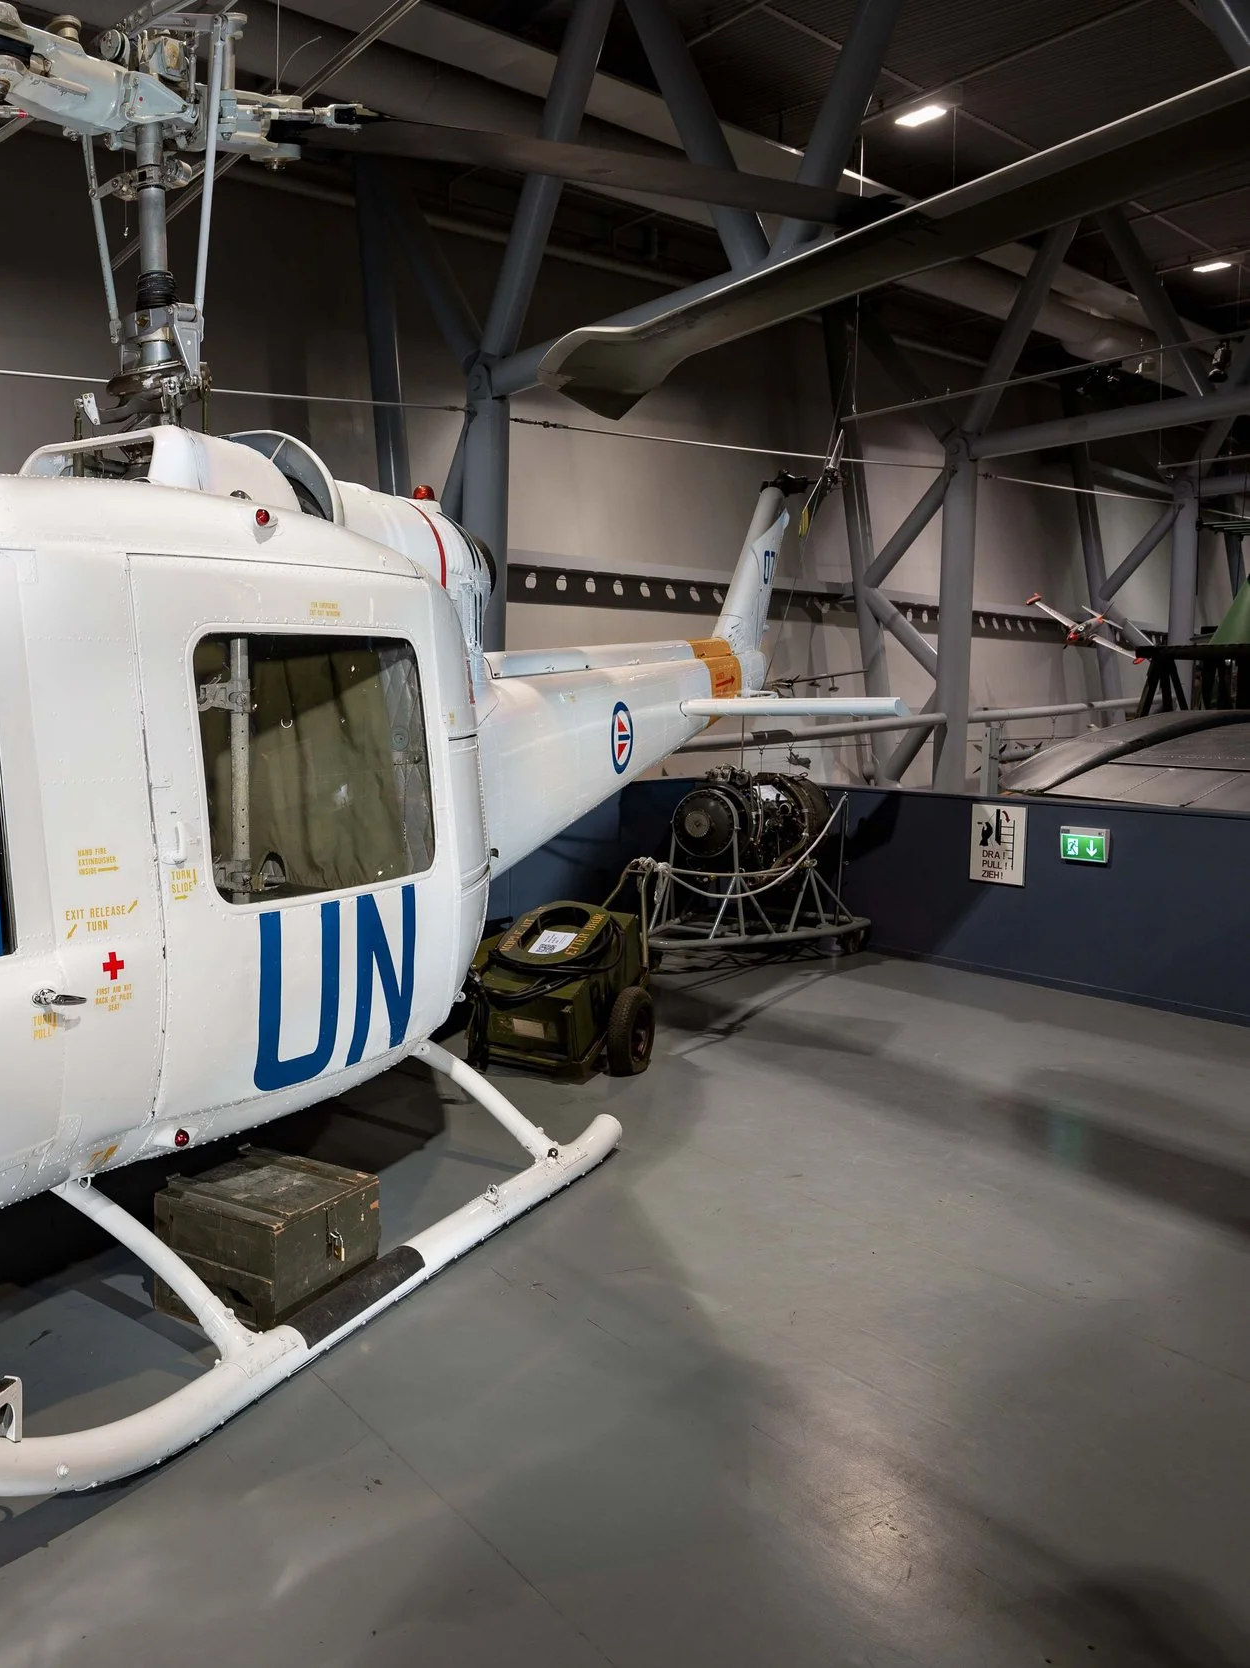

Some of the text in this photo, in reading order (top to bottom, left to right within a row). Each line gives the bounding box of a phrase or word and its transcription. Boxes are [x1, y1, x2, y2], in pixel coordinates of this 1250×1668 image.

[78, 847, 107, 857] HAND FIRE
[982, 850, 1001, 859] DRA
[78, 856, 117, 866] EXTINGUISHER
[982, 860, 1002, 869] PULL
[79, 867, 97, 876] INSIDE
[171, 869, 192, 881] TURN
[171, 881, 193, 894] SLIDE
[65, 905, 127, 921] EXIT RELEASE
[86, 920, 108, 932] TURN
[96, 983, 132, 996] FIRST AID KIT
[254, 884, 416, 1092] UN
[95, 992, 133, 1005] BACK OF PILOT
[108, 1003, 120, 1012] SEAT
[33, 1011, 53, 1027] TURN
[33, 1027, 52, 1041] PULL
